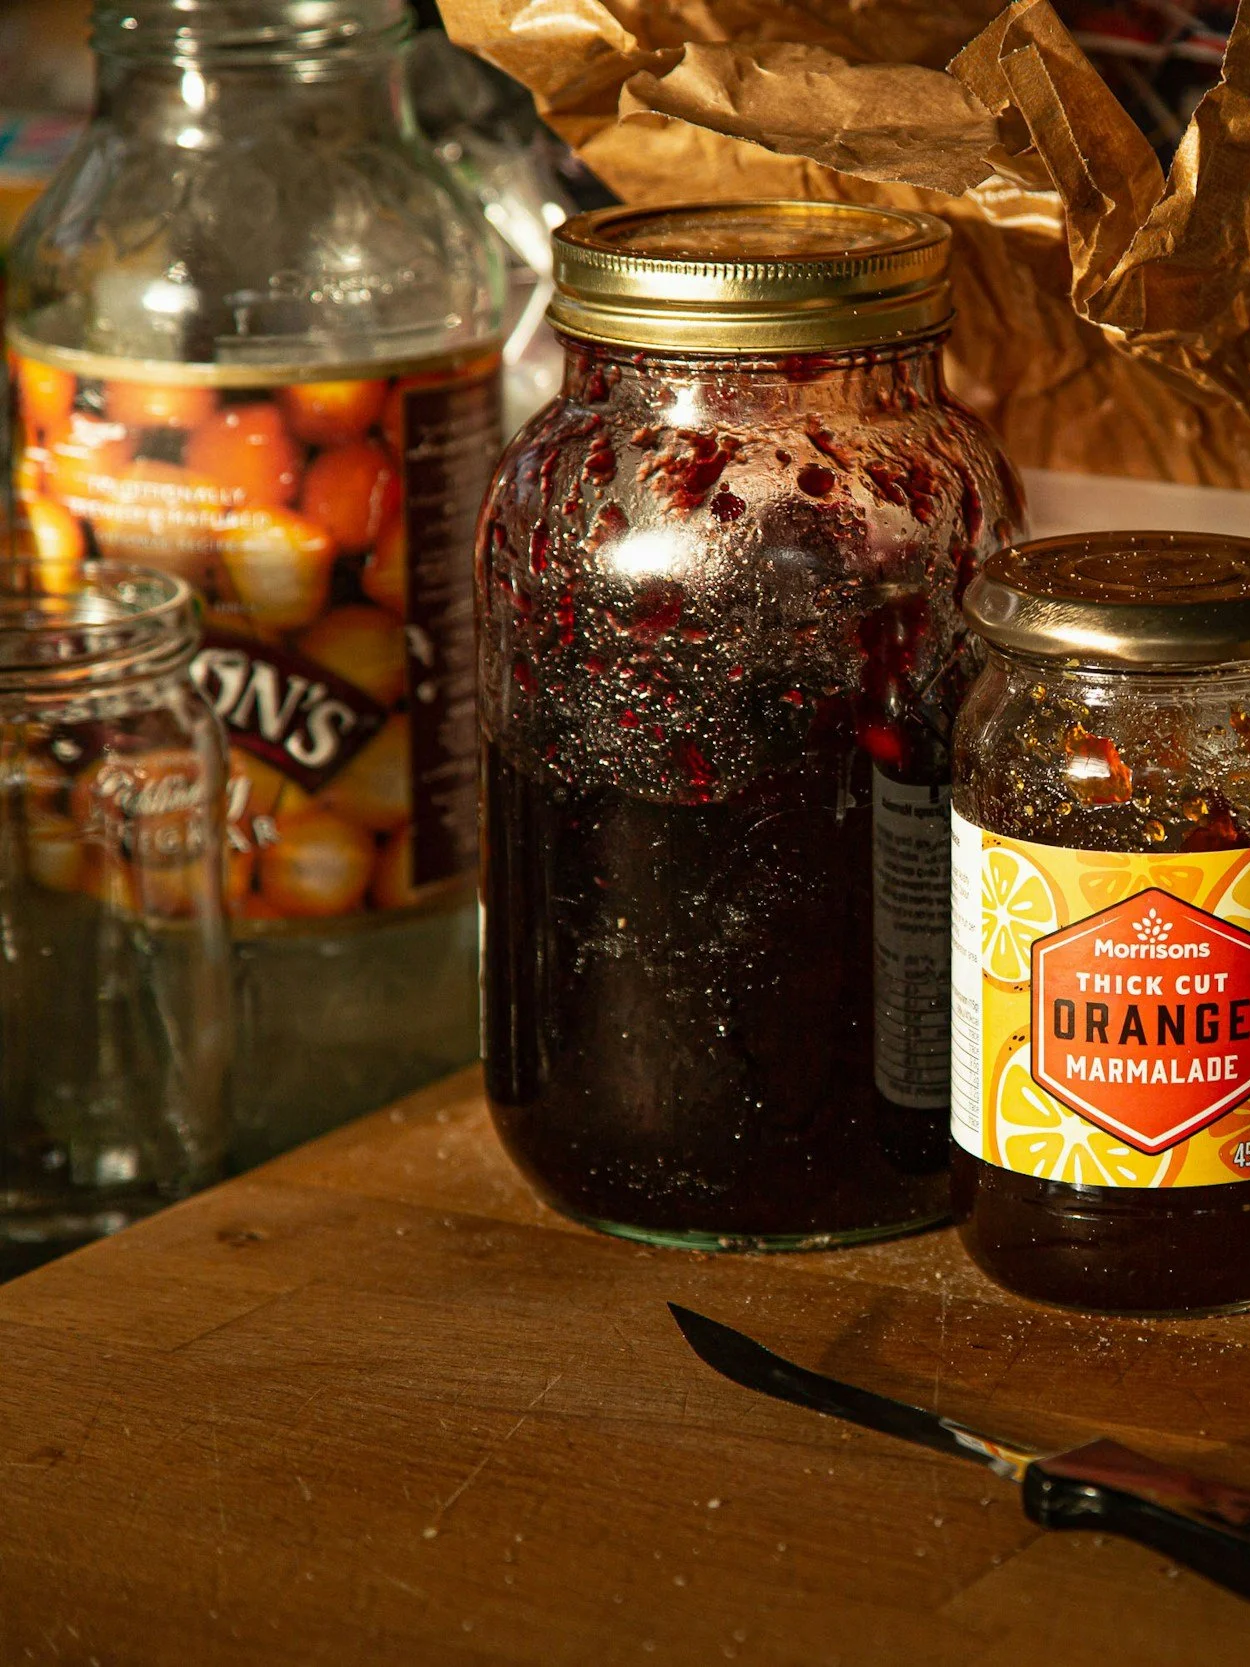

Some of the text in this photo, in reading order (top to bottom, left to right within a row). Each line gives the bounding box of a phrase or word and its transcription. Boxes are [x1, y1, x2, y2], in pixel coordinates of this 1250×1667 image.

[1094, 938, 1211, 959] Morrisons
[1076, 972, 1229, 996] THICK CUT
[1066, 1054, 1239, 1085] MARMALADE
